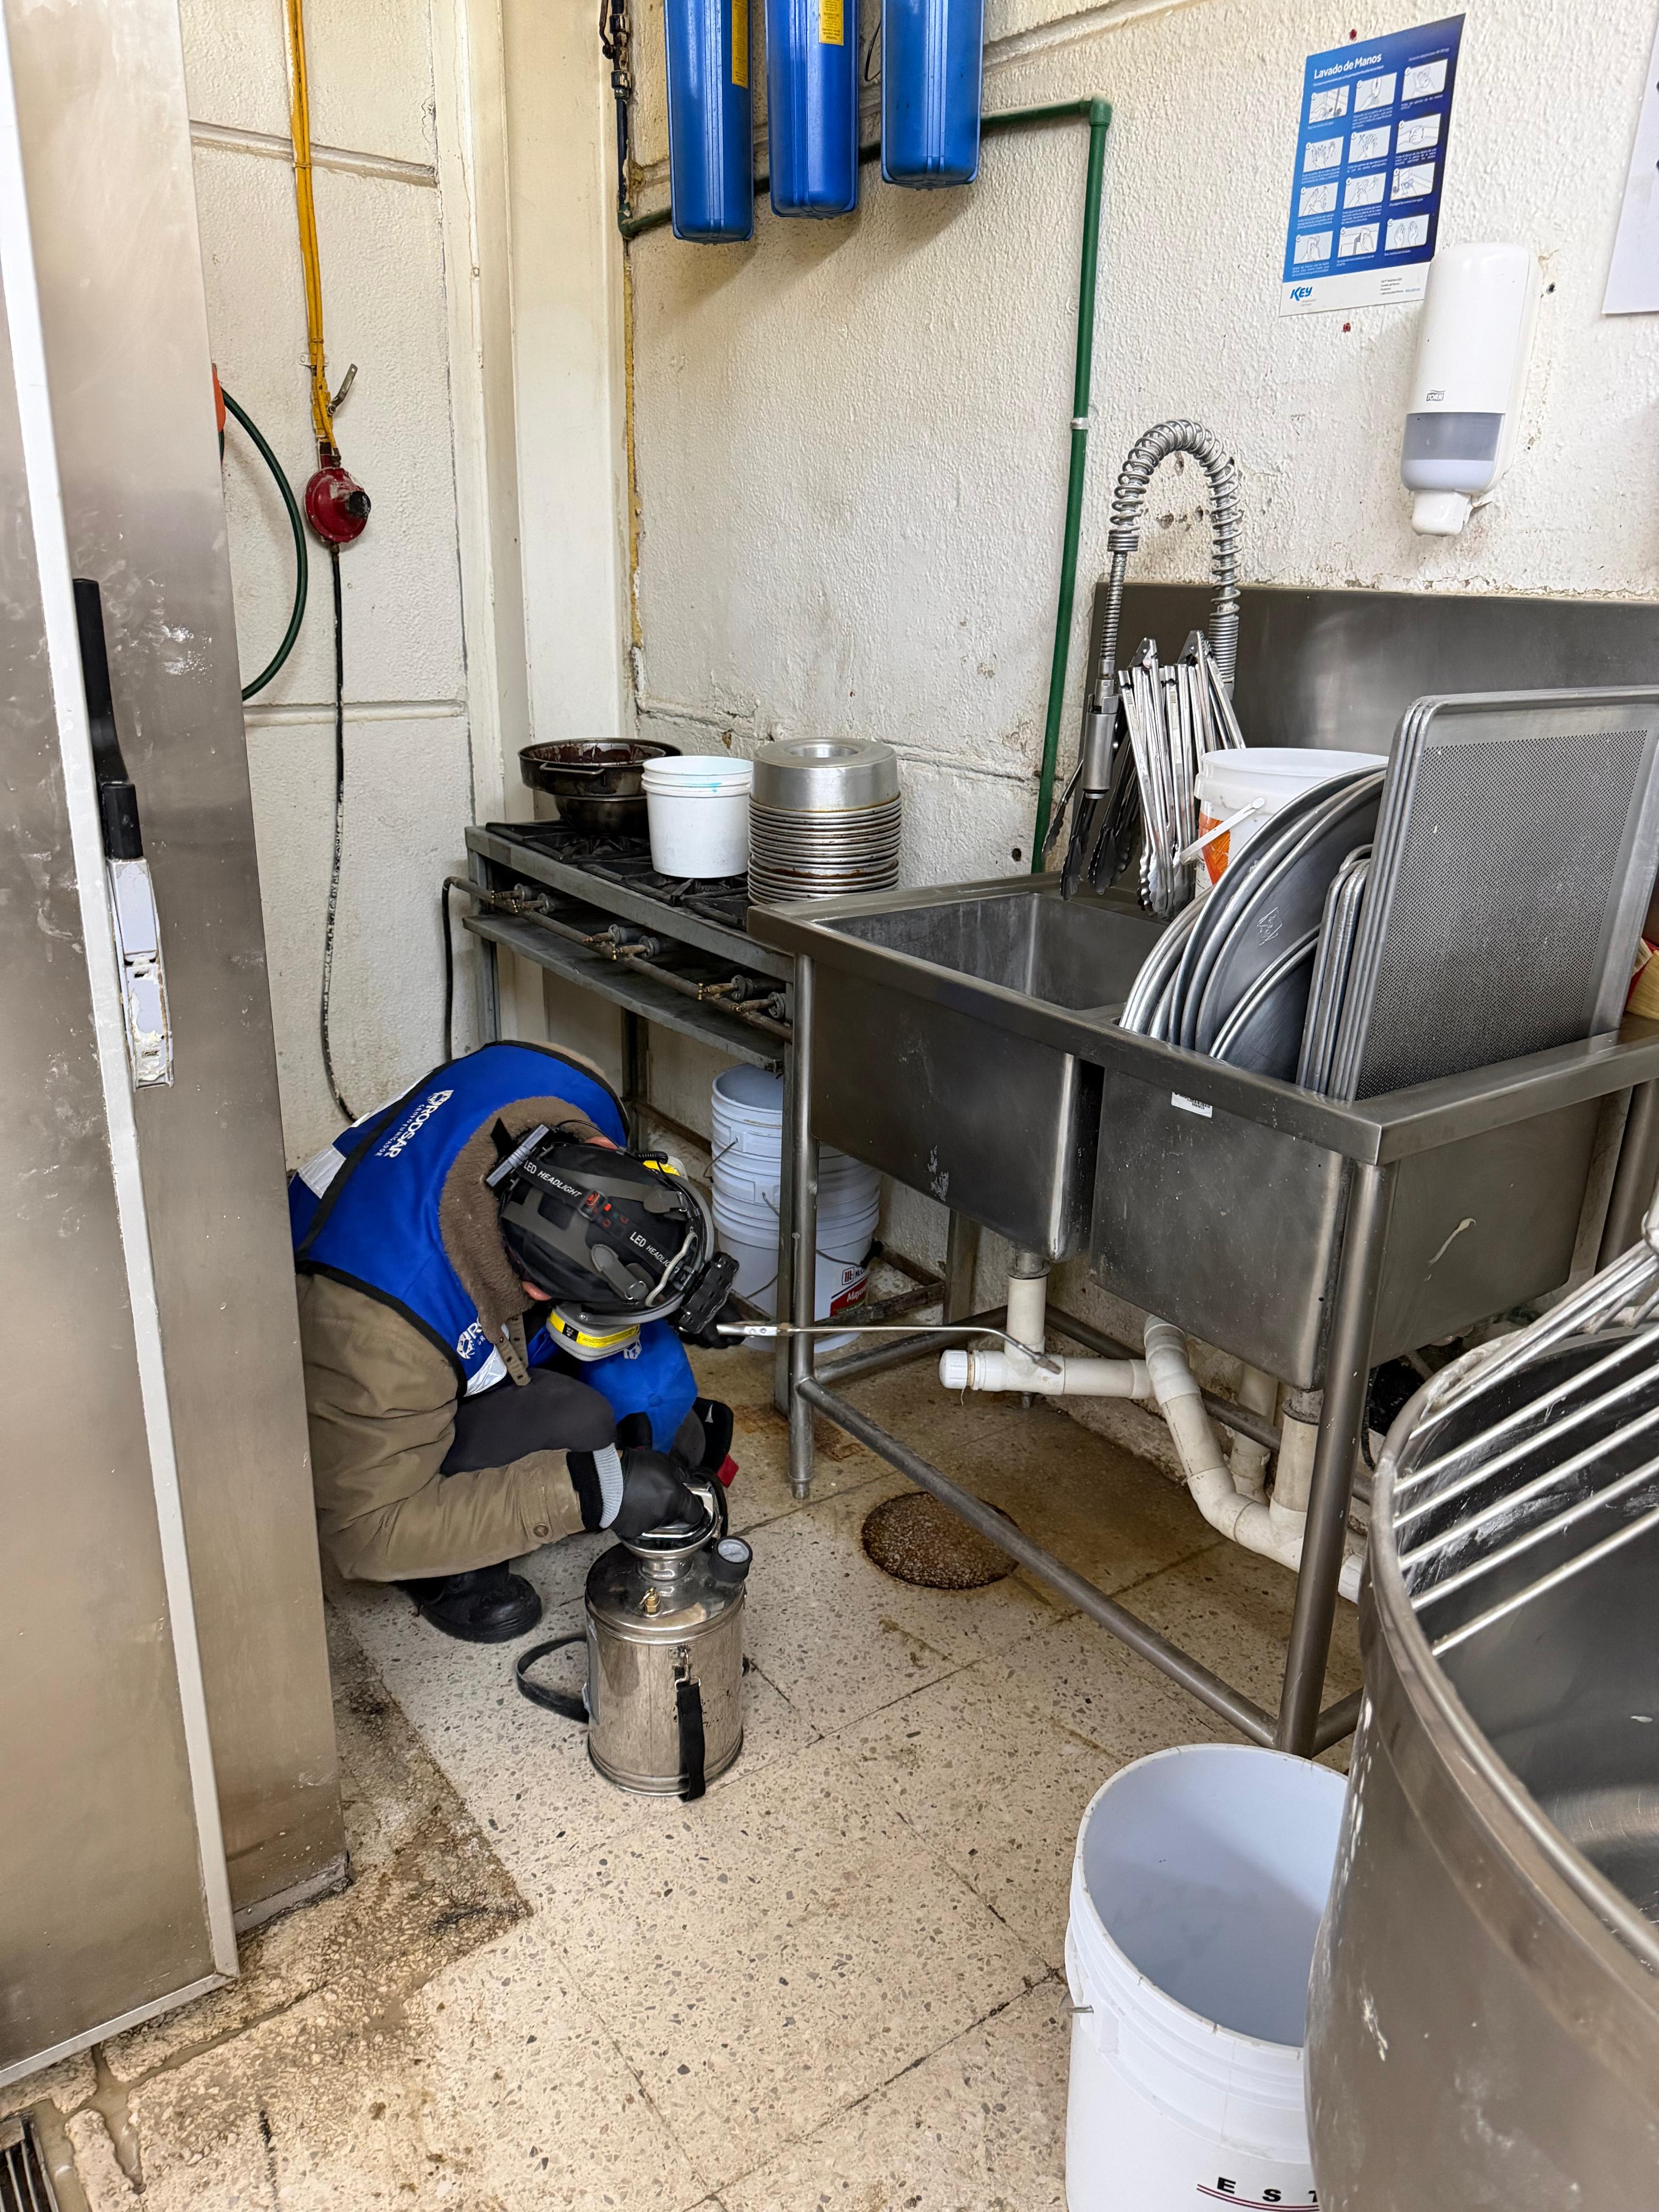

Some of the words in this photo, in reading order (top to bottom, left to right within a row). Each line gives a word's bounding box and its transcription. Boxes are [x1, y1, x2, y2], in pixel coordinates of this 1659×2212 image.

[1314, 64, 1343, 79] Lavado
[1343, 61, 1354, 71] de
[1354, 54, 1381, 69] Manos
[383, 1105, 439, 1158] RODSAR
[524, 1160, 537, 1174] LED
[538, 1170, 582, 1197] HEADLIGHT
[630, 1231, 647, 1247] LED
